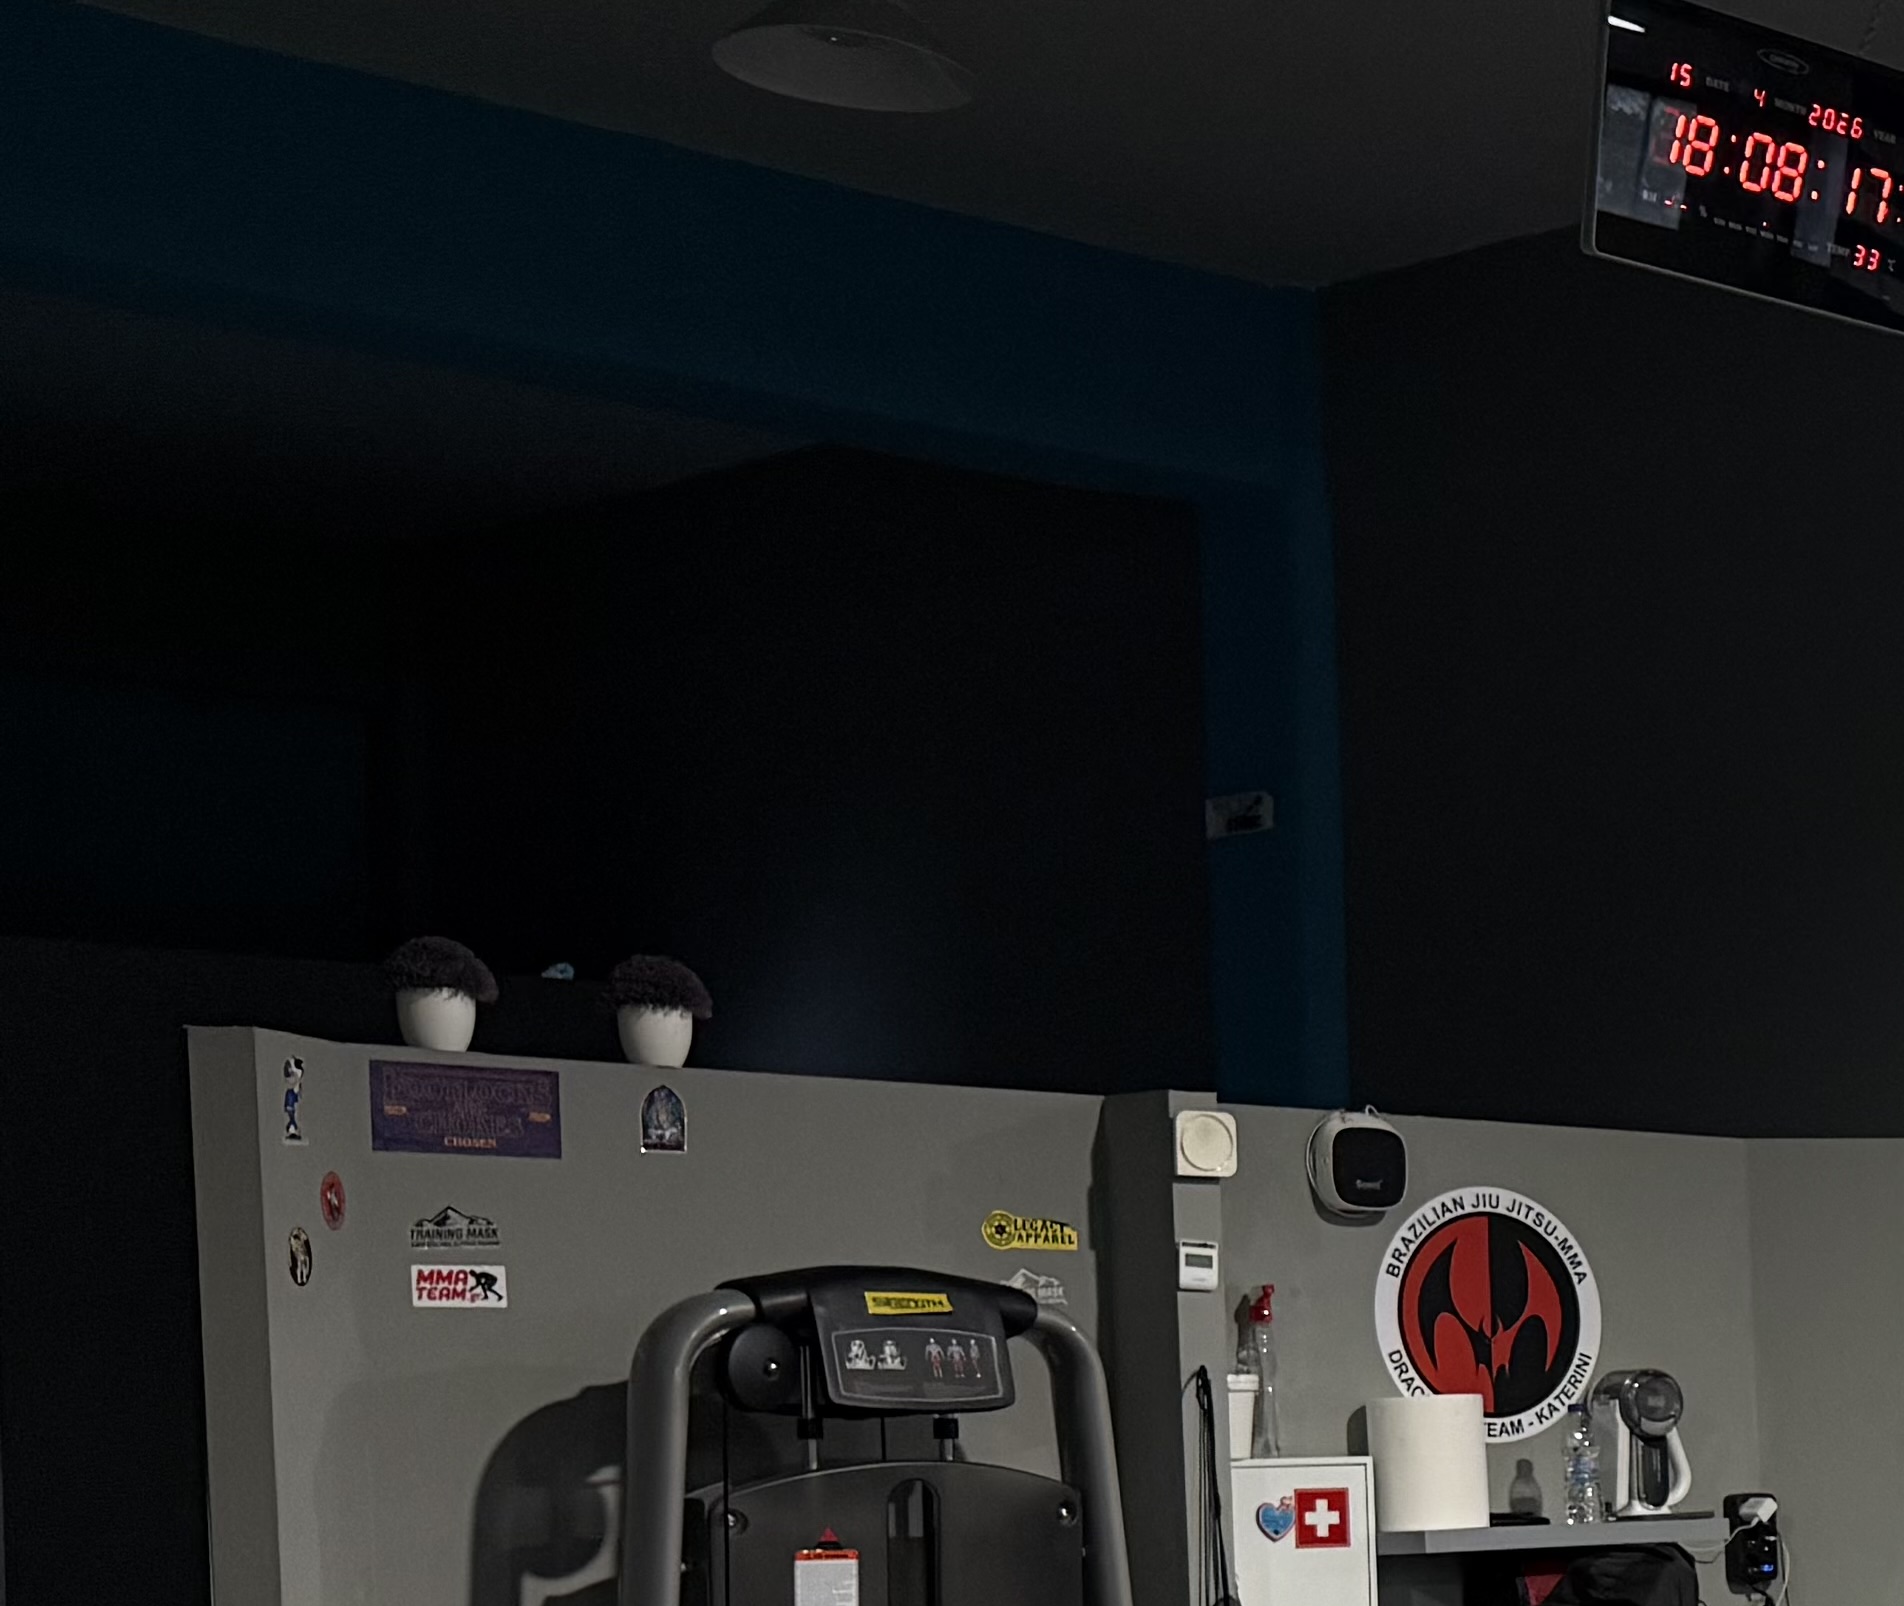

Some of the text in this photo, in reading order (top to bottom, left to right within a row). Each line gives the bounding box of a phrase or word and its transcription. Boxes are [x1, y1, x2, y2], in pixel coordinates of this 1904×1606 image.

[1669, 61, 1693, 88] 15
[1753, 88, 1767, 108] 4
[1852, 244, 1881, 271] 33
[1386, 1193, 1588, 1285] BRAZILIAN JIU JITSU-MMA
[416, 1268, 469, 1286] MMA
[416, 1286, 467, 1301] TEAM
[1484, 1418, 1524, 1438] EAM
[1535, 1352, 1592, 1425] KATERINI
